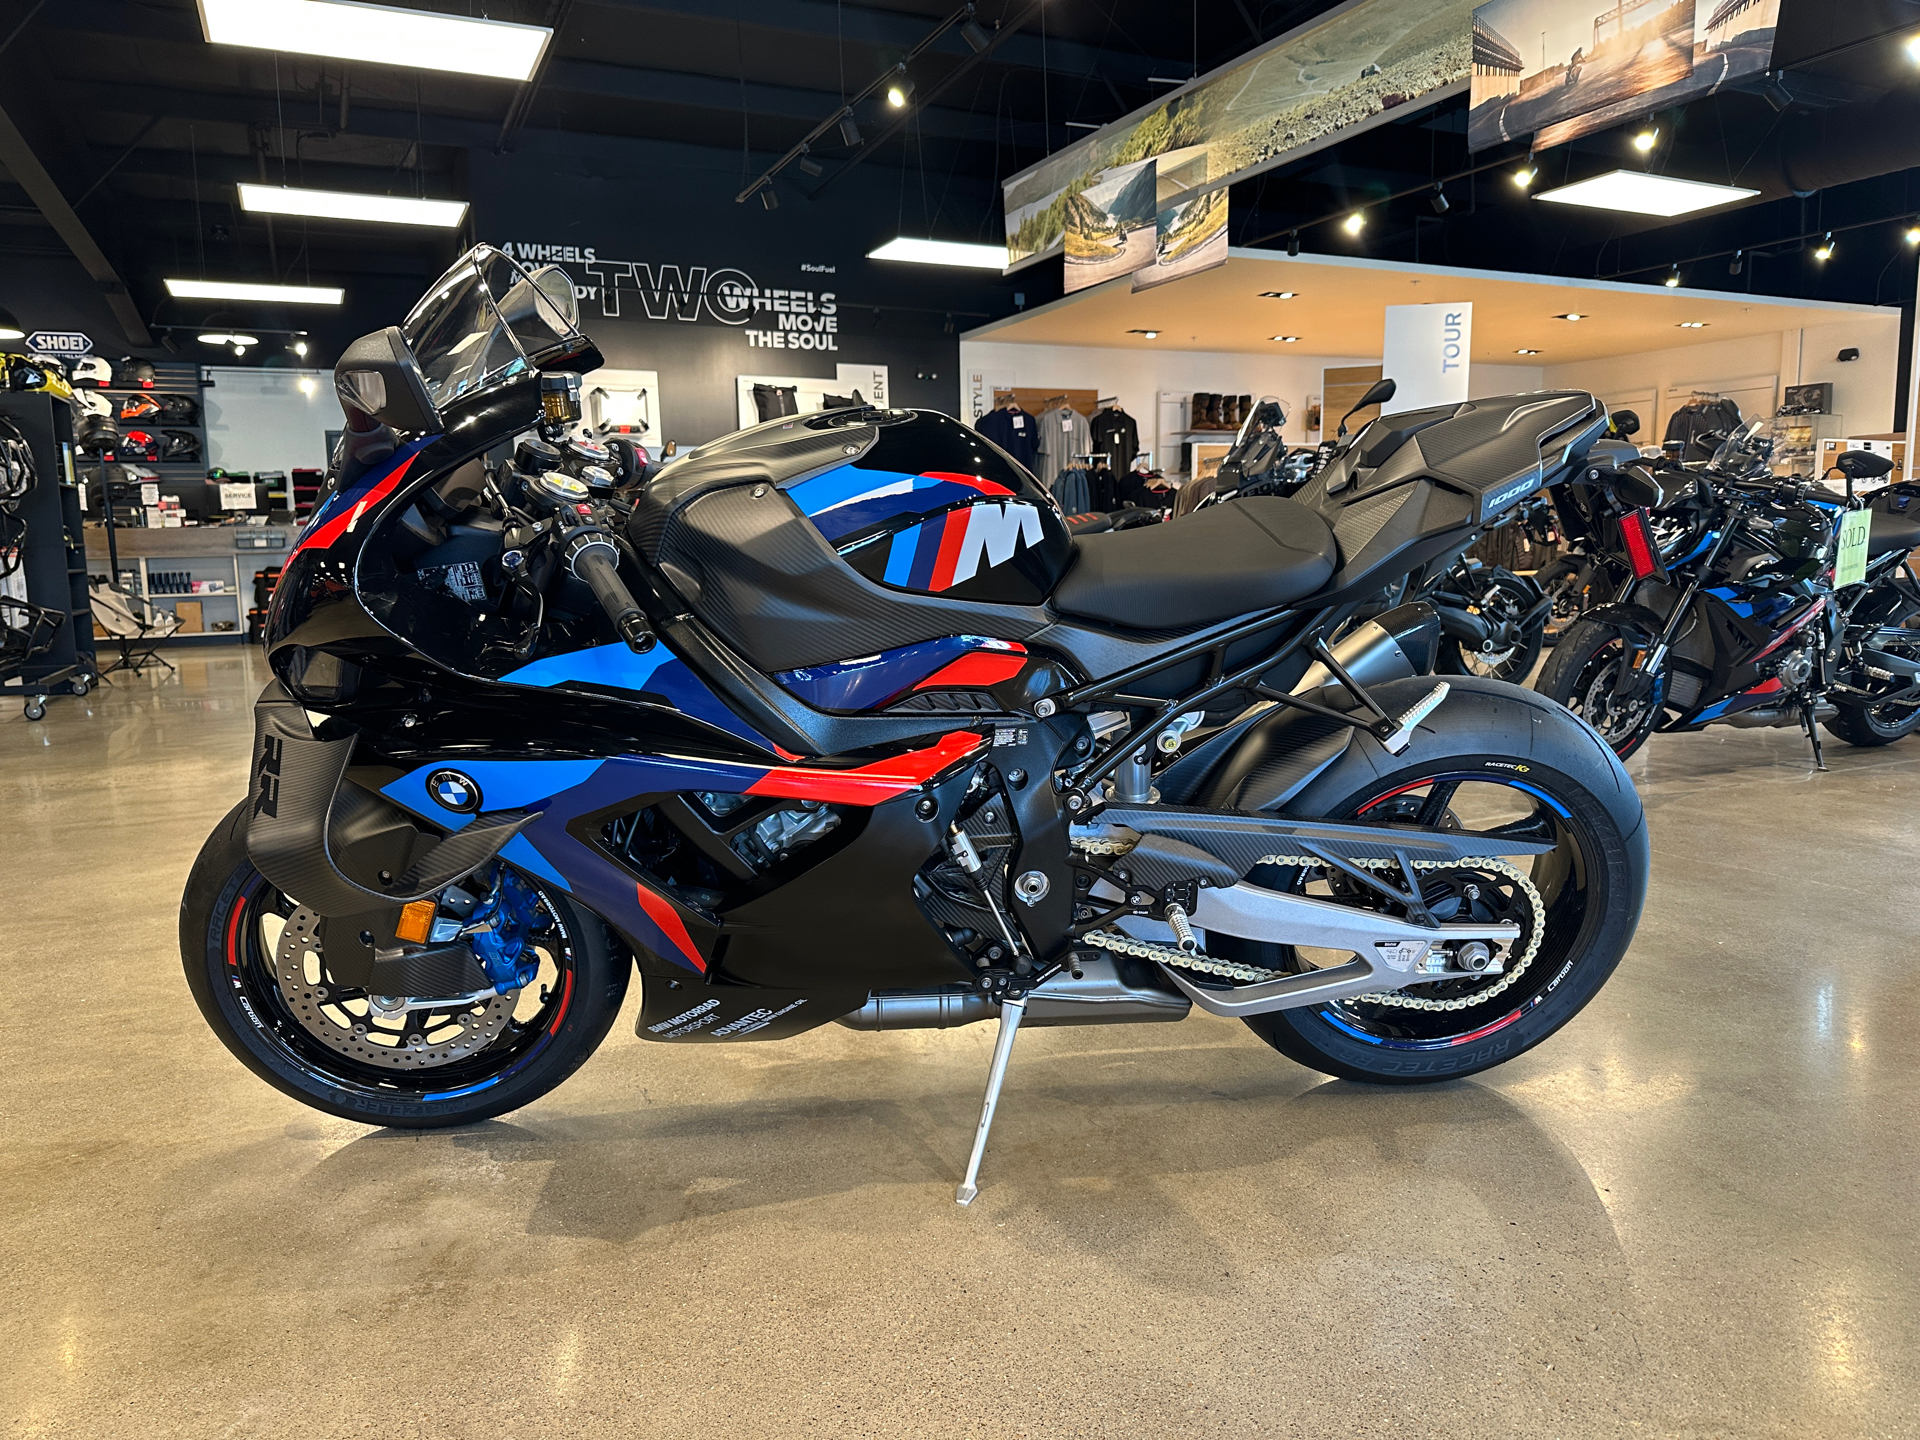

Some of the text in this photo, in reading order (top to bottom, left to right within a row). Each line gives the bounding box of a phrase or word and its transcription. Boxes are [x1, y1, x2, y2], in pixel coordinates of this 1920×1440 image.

[502, 242, 596, 264] 4 WHEELS
[801, 263, 836, 274] #SoulFuel
[585, 259, 757, 326] TWO
[722, 286, 838, 316] WHEELS
[778, 313, 838, 333] MOVE
[35, 335, 84, 350] SHOEI
[745, 330, 839, 351] THE SOUL
[1442, 312, 1462, 374] TOUR
[973, 374, 983, 419] STYLE
[1487, 478, 1536, 509] 1000
[951, 503, 1045, 588] M
[1841, 526, 1866, 550] SOLD
[253, 734, 283, 819] RR
[431, 773, 468, 788] BMW
[1485, 761, 1517, 770] RACETEC
[537, 890, 562, 923] MOTORRAD
[1547, 959, 1574, 992] Carbon
[647, 999, 721, 1033] BMW MOTORRAD
[662, 1012, 721, 1039] MOTORSPORT
[710, 1008, 773, 1037] ADVANTEC
[1382, 1038, 1511, 1073] RACETEC
